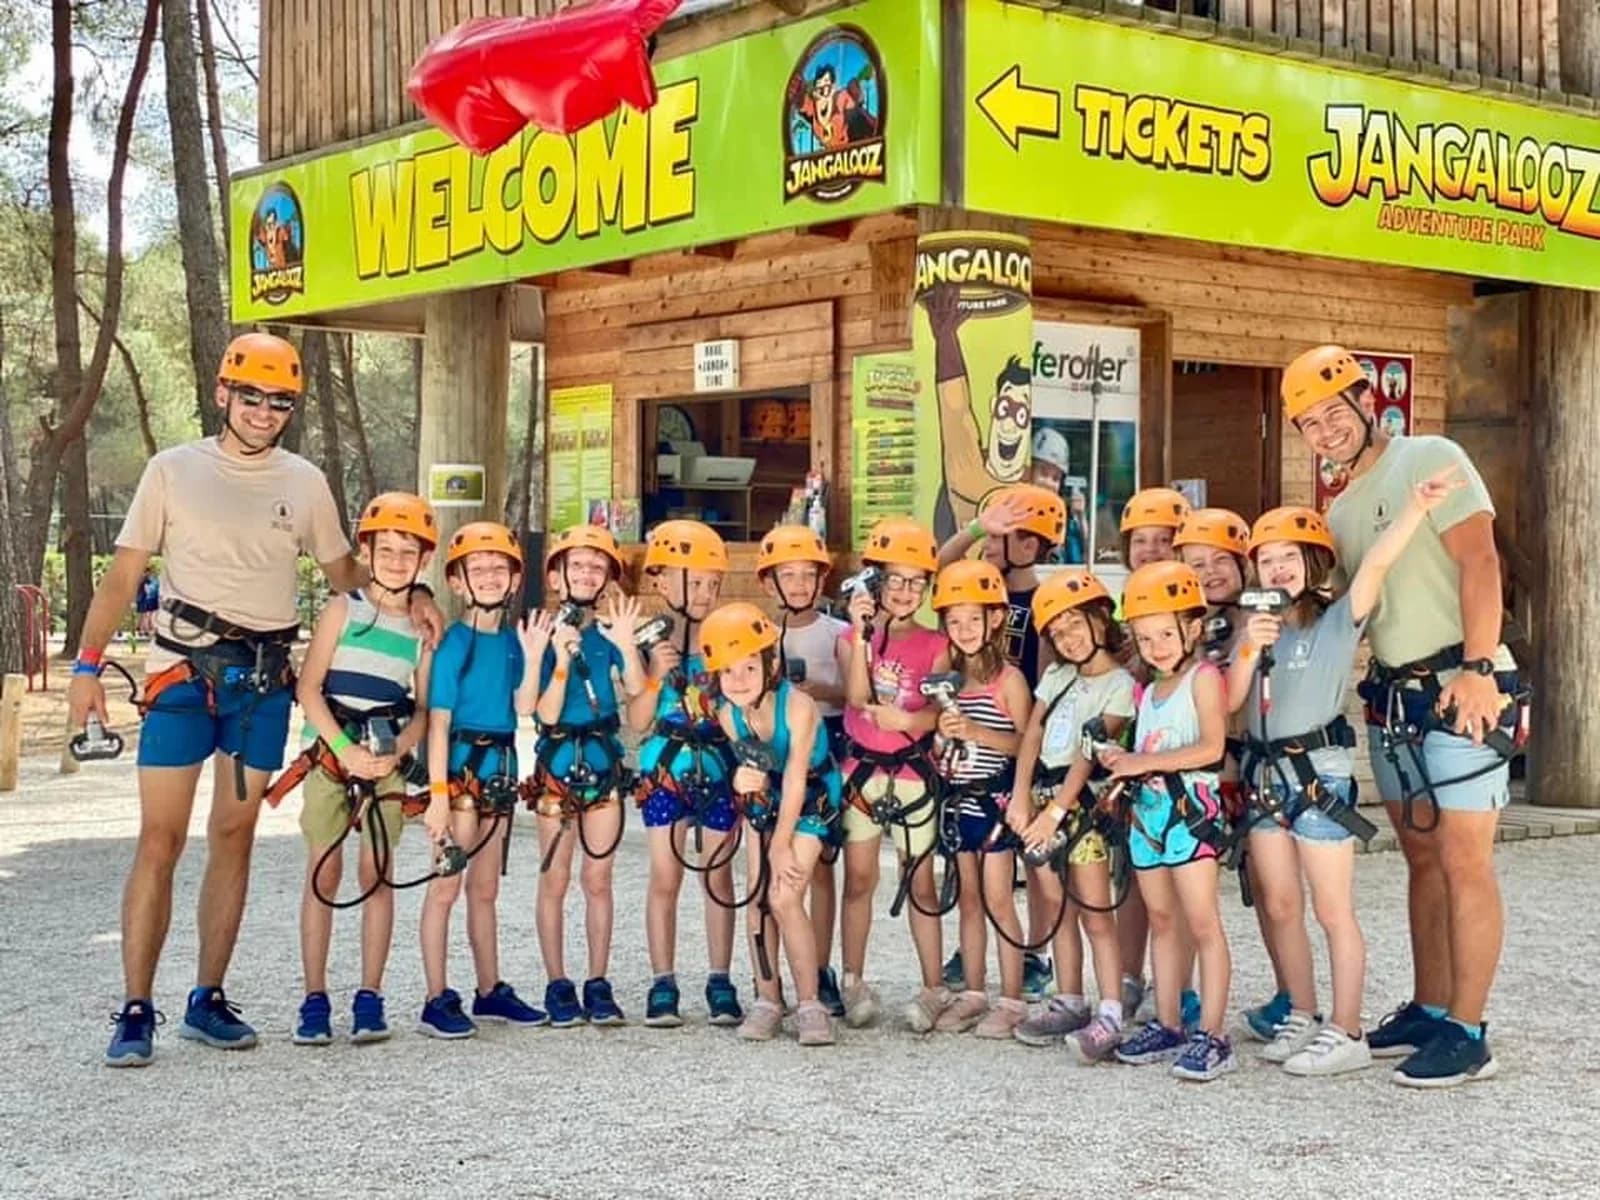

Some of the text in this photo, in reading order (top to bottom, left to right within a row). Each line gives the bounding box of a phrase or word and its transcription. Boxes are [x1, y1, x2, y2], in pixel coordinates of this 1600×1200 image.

[350, 78, 699, 279] WELCOME
[786, 143, 883, 193] JANGALOOZ
[1075, 84, 1271, 183] TICKETS
[1307, 104, 1600, 239] JANGALOOZ
[1378, 204, 1546, 251] ADVENTURE PARK
